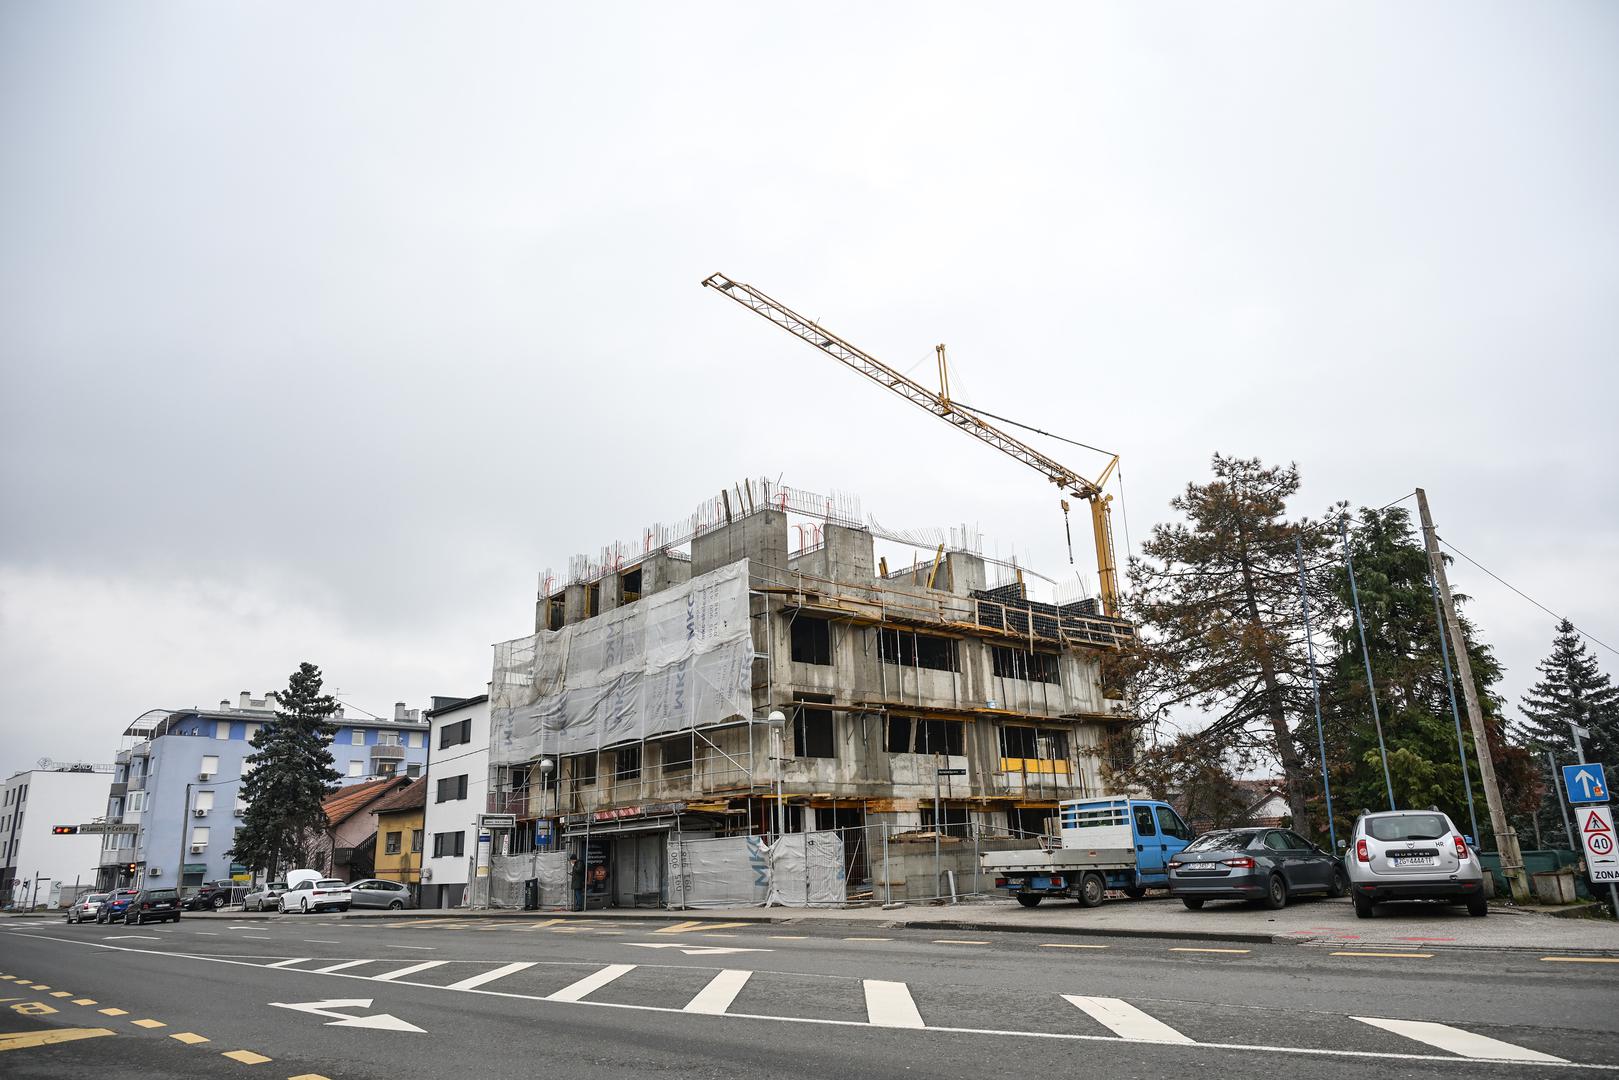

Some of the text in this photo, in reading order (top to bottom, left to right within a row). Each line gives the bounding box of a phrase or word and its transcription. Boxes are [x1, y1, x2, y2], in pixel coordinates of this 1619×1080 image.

[1593, 838, 1609, 850] 40
[670, 851, 679, 869] 900
[1594, 870, 1619, 880] ZONA
